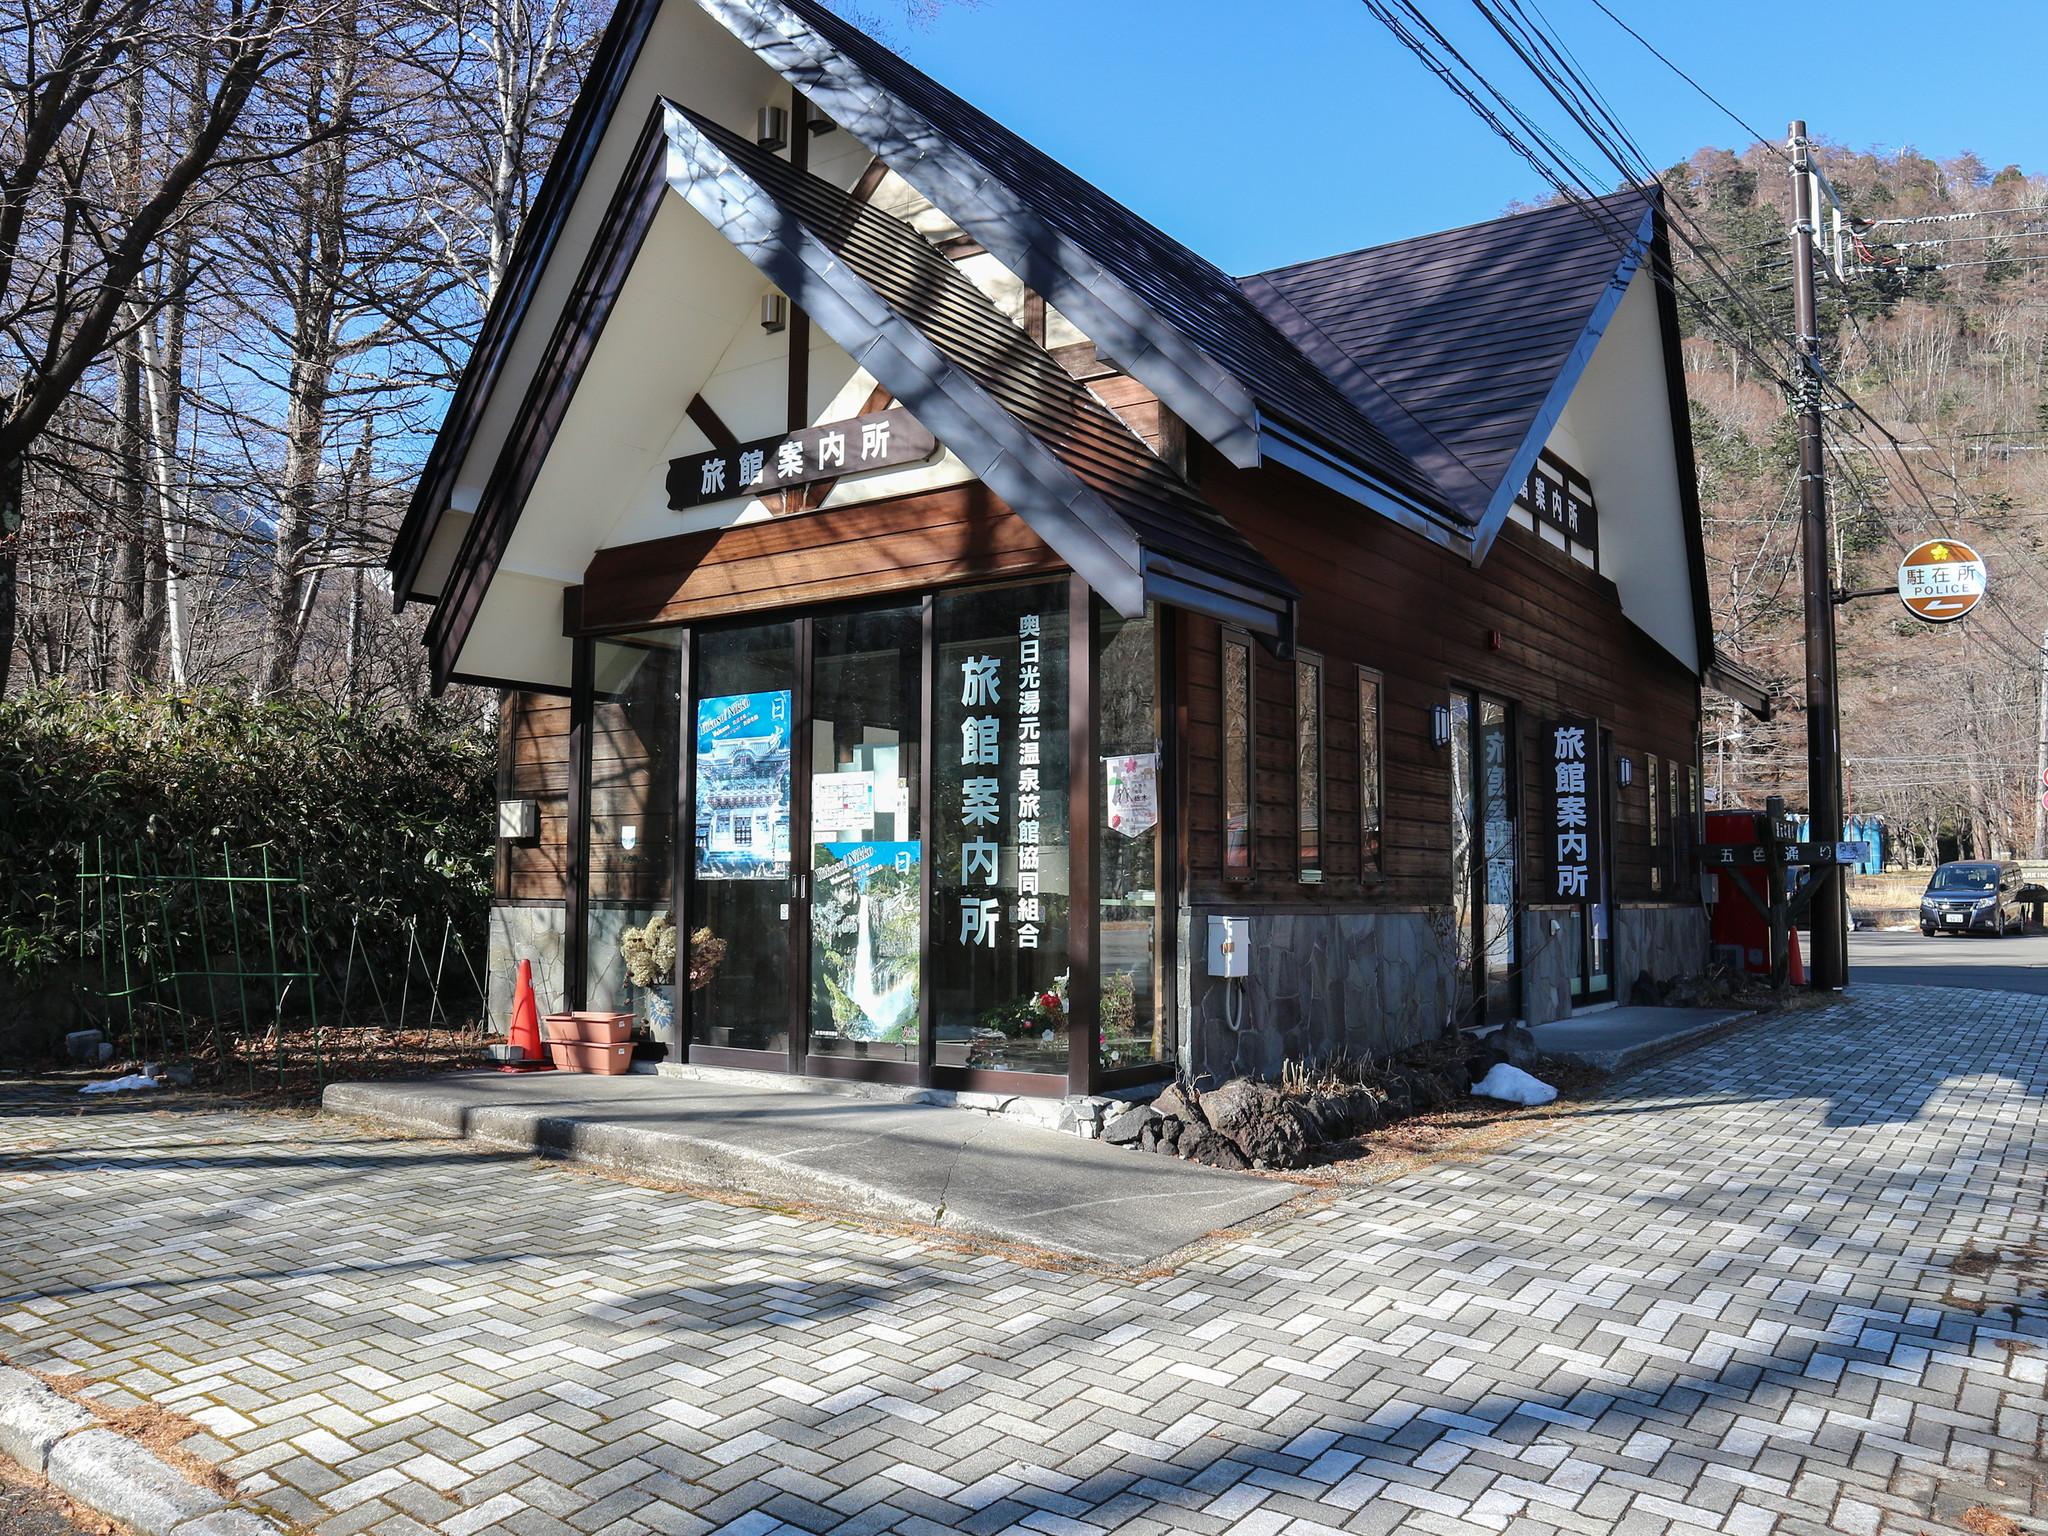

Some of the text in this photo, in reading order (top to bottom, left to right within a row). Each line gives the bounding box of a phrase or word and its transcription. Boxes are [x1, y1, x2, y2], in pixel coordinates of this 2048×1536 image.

[701, 420, 891, 495] 旅館案内所
[1906, 564, 1976, 586] 駐在所
[1914, 584, 1970, 596] POLICE
[960, 655, 1001, 949] 旅館案内所
[1018, 614, 1041, 949] 奥日光湯元温泉旅館協同組合
[1553, 726, 1588, 897] 旅館案内所
[1720, 845, 1832, 863] 五色通り
